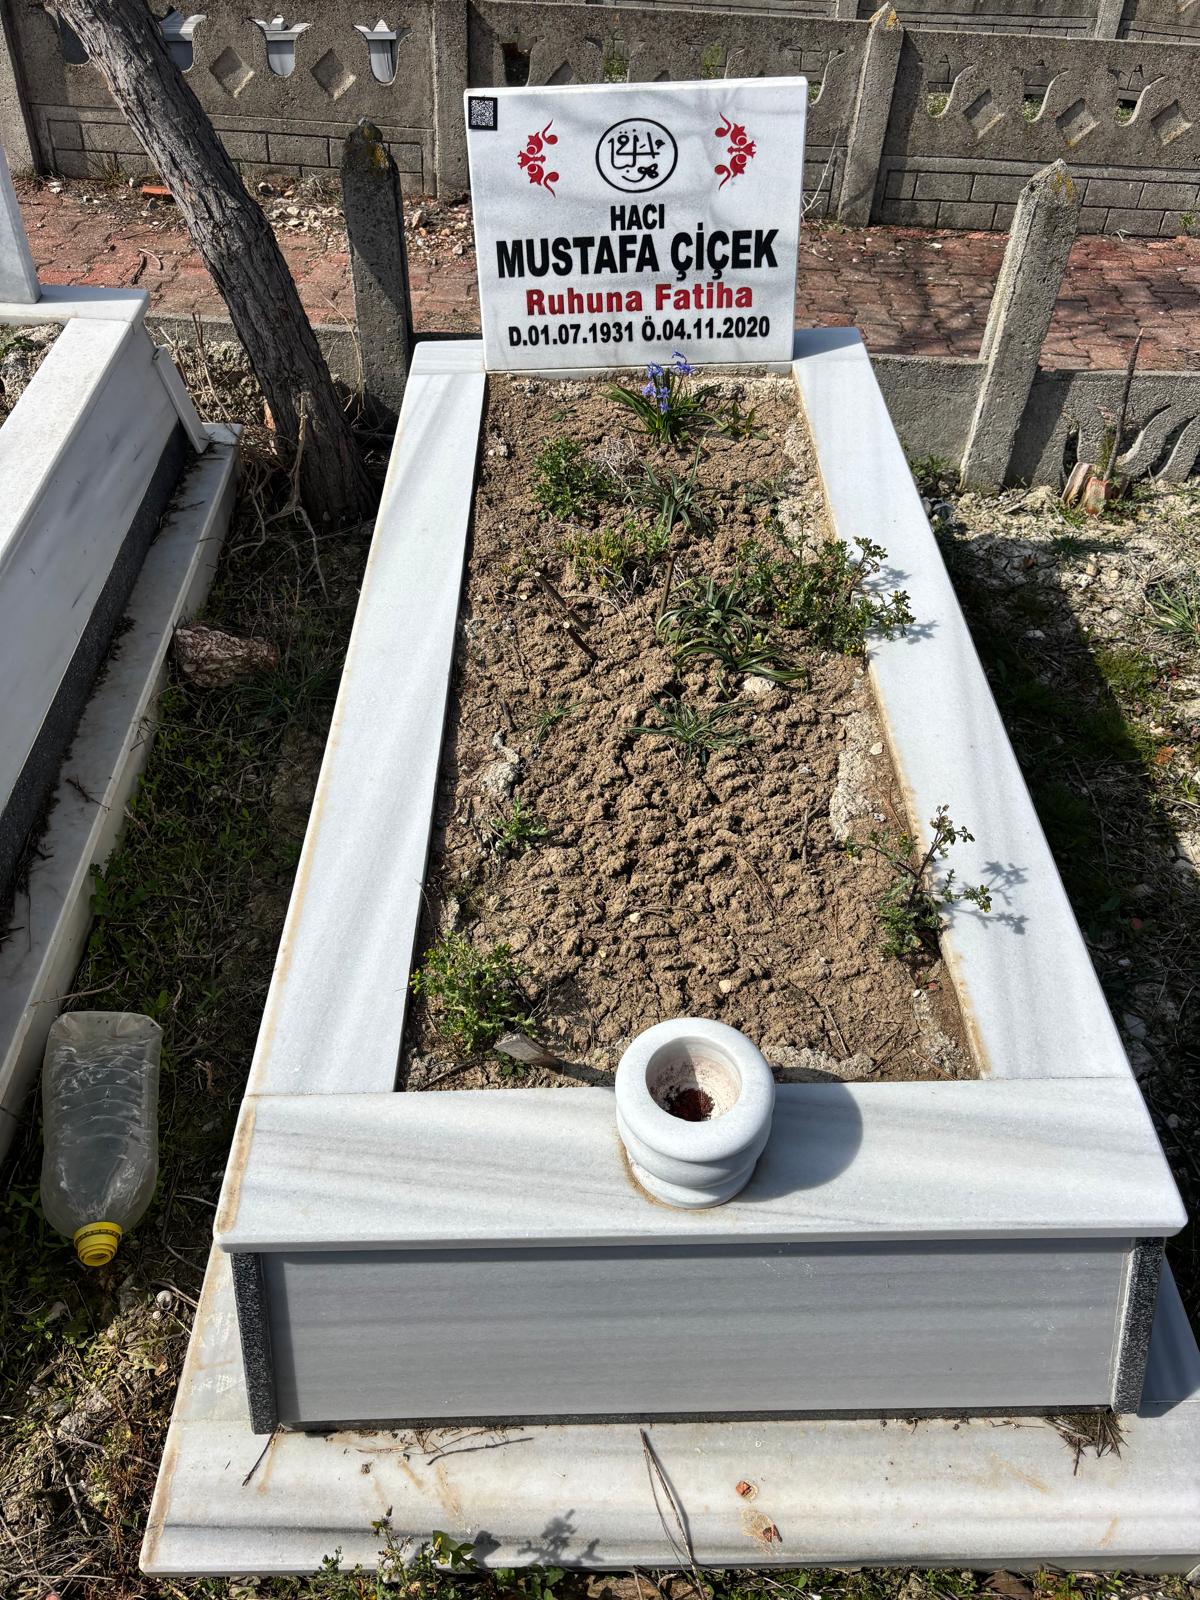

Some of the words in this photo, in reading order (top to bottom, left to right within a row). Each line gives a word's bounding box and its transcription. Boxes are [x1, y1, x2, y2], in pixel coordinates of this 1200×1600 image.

[610, 203, 665, 231] HACI
[495, 234, 661, 279] MUSTAFA
[670, 221, 780, 282] ÇİÇEK
[526, 288, 643, 316] Ruhuna
[655, 281, 753, 311] Fatiha
[508, 321, 634, 347] D.01.07.1931
[641, 315, 771, 342] Ö.04.11.2020
